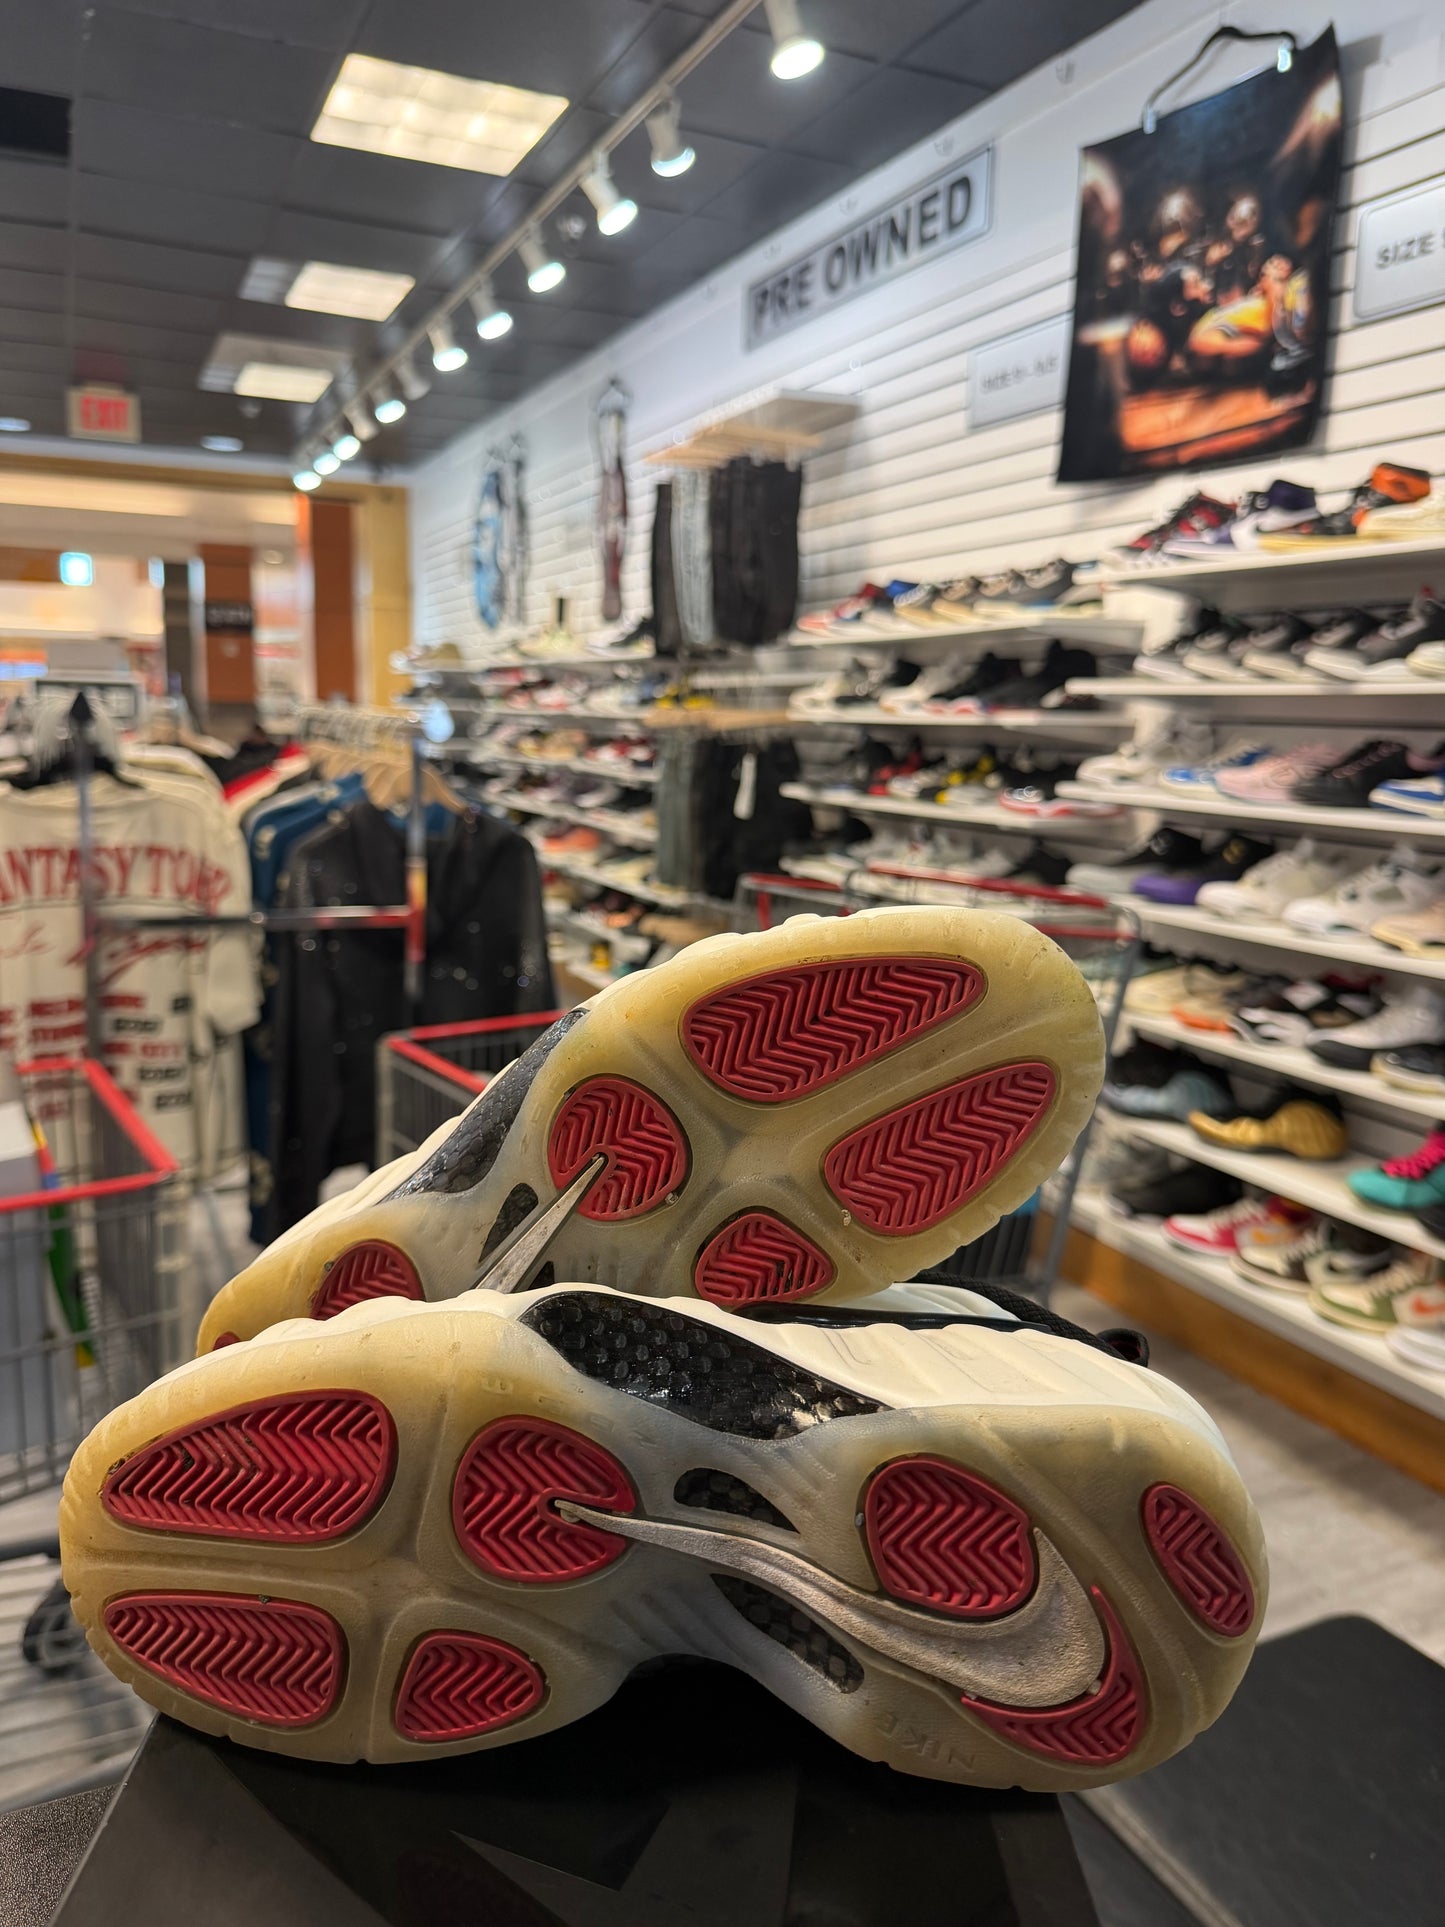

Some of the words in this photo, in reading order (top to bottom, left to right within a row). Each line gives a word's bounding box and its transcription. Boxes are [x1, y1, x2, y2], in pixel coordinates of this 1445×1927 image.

[752, 261, 813, 335] PRE
[824, 176, 971, 293] OWNED
[1375, 230, 1434, 270] SIZE
[81, 396, 129, 432] EXIT
[876, 1711, 977, 1773] NIKE
